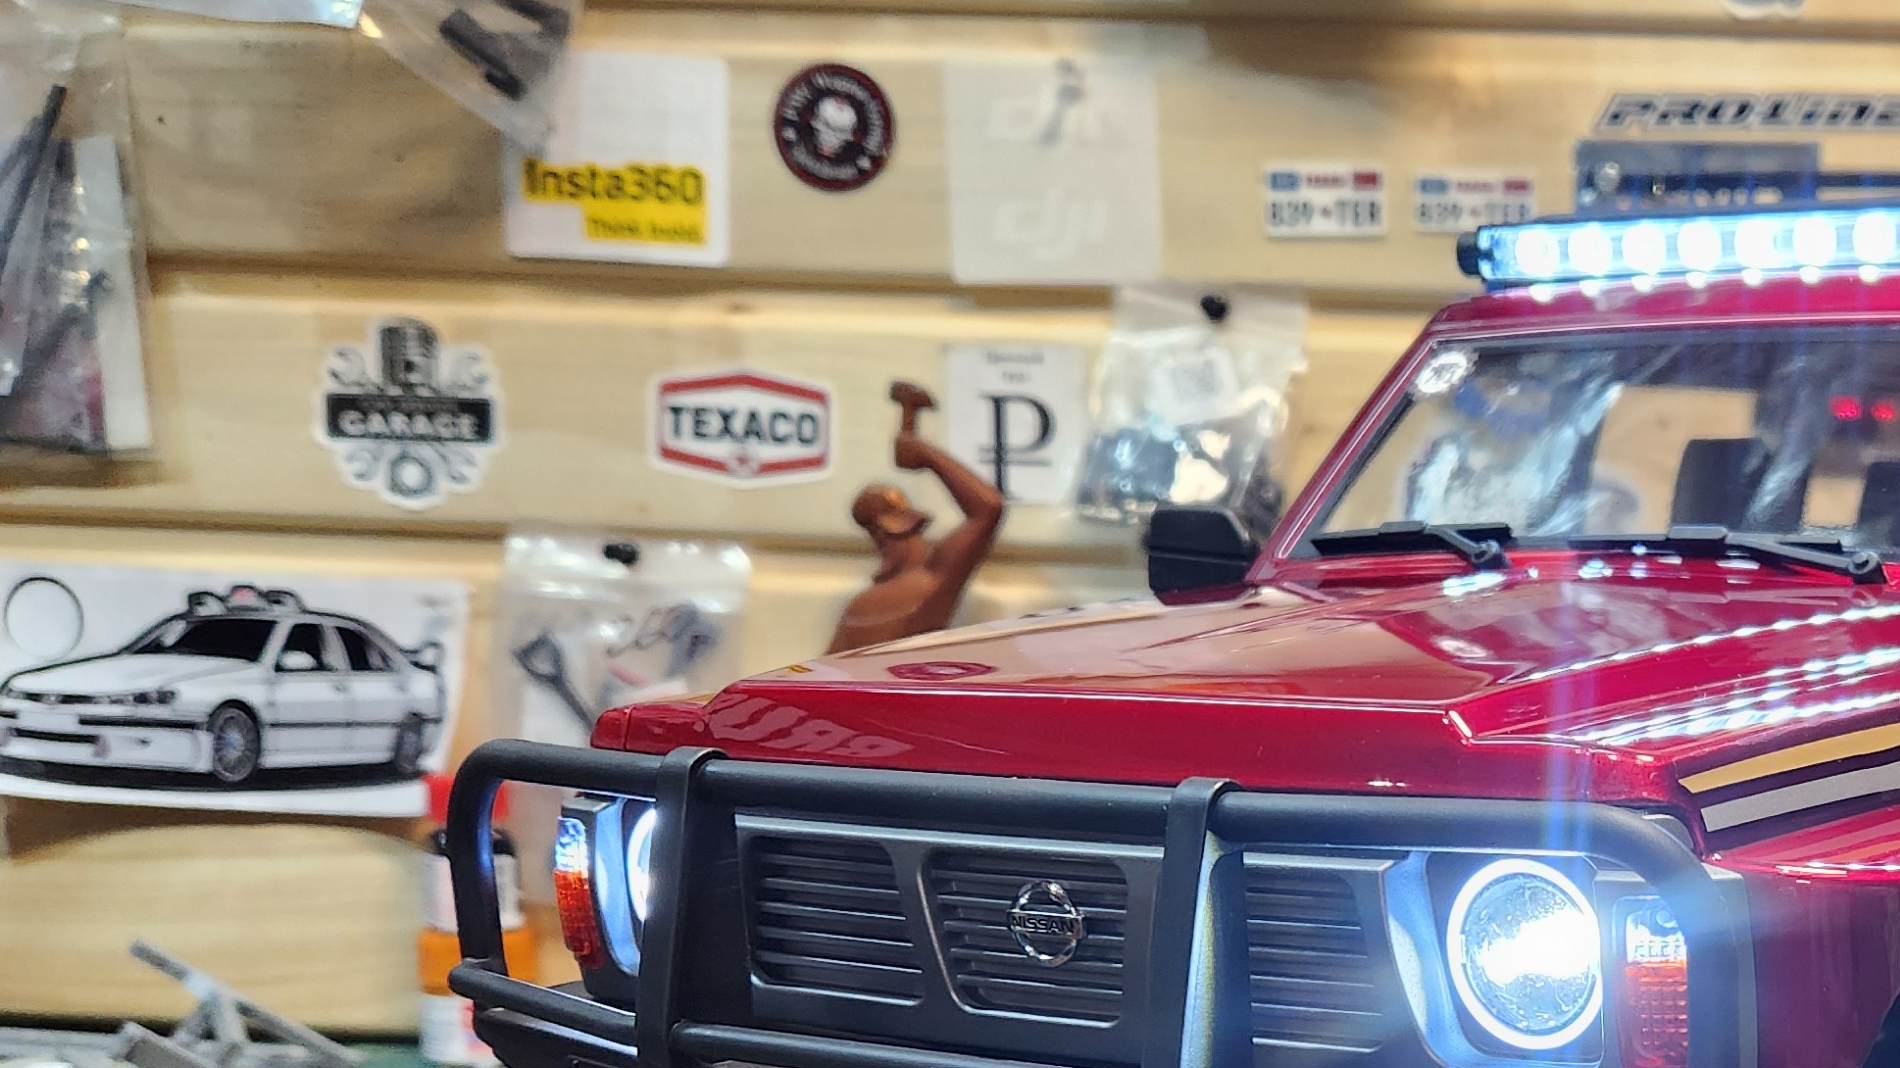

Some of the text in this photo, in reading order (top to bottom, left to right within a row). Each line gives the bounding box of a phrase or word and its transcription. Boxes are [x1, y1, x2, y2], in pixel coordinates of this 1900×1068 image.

[523, 157, 706, 206] Insta360
[338, 409, 479, 440] GARAGE
[668, 405, 820, 445] TEXACO
[1011, 914, 1076, 935] NISSAN
